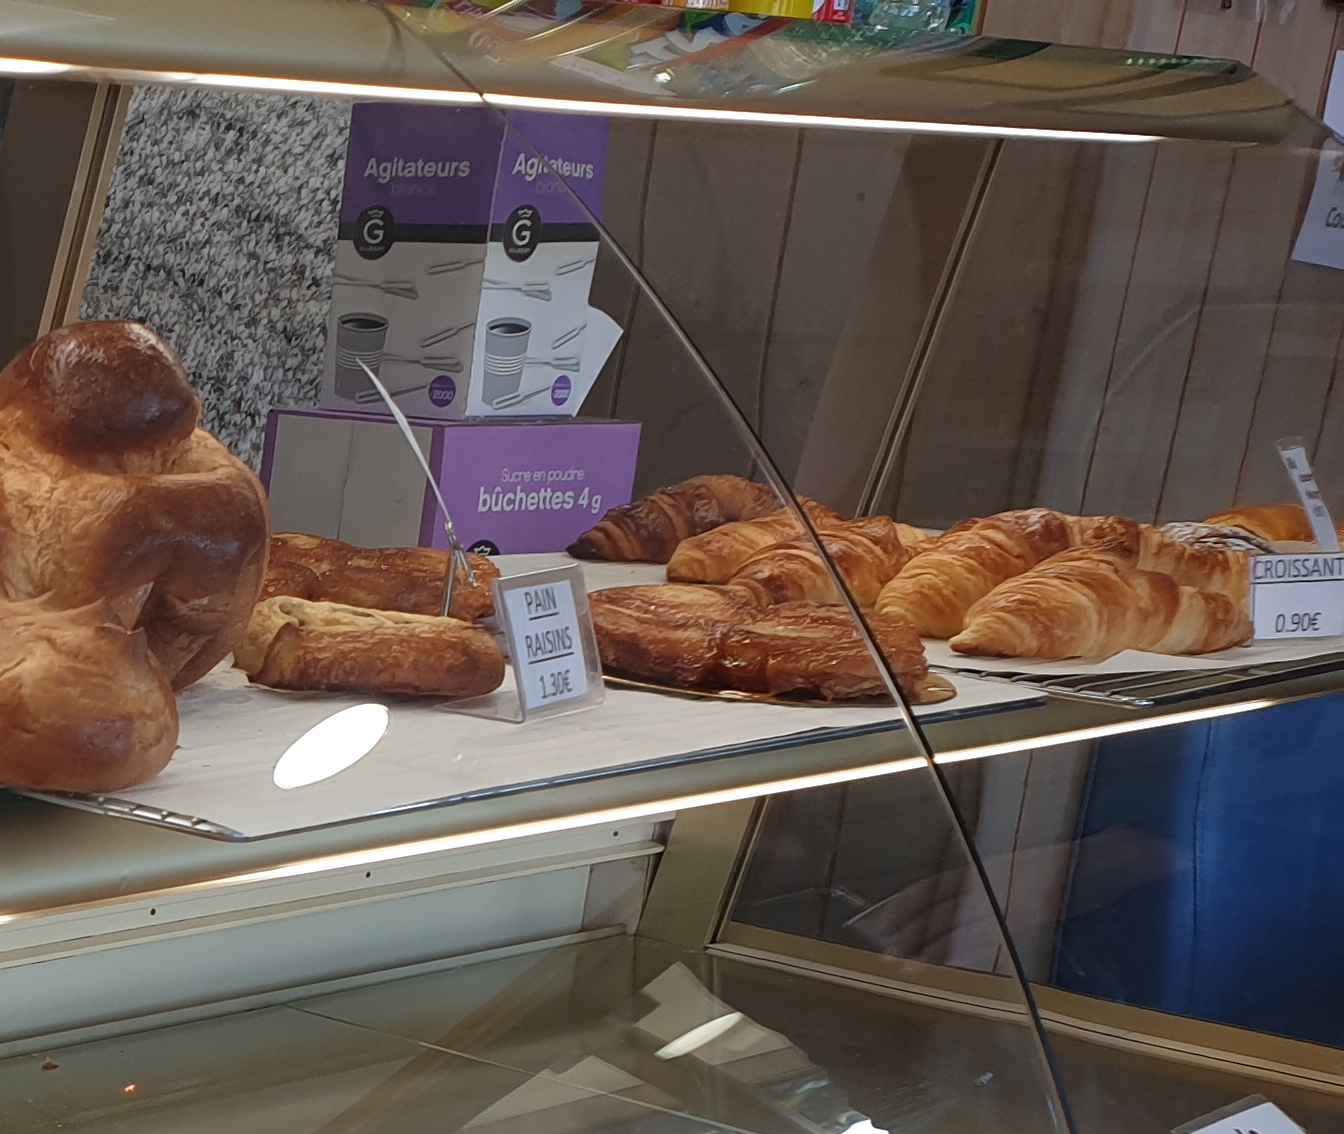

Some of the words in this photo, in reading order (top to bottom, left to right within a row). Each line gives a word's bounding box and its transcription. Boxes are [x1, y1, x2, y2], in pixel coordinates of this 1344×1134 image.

[363, 157, 470, 184] Agitateurs
[512, 153, 594, 182] Agitateurs
[501, 468, 531, 483] Sucre
[533, 470, 545, 482] en
[547, 468, 584, 484] poudre
[478, 485, 574, 512] bûchettes
[578, 487, 589, 509] 4
[592, 494, 601, 514] g
[1253, 557, 1344, 580] CROISSANT
[524, 587, 557, 615] PAIN
[1275, 612, 1321, 633] 0.90€
[525, 626, 572, 658] RAISINS
